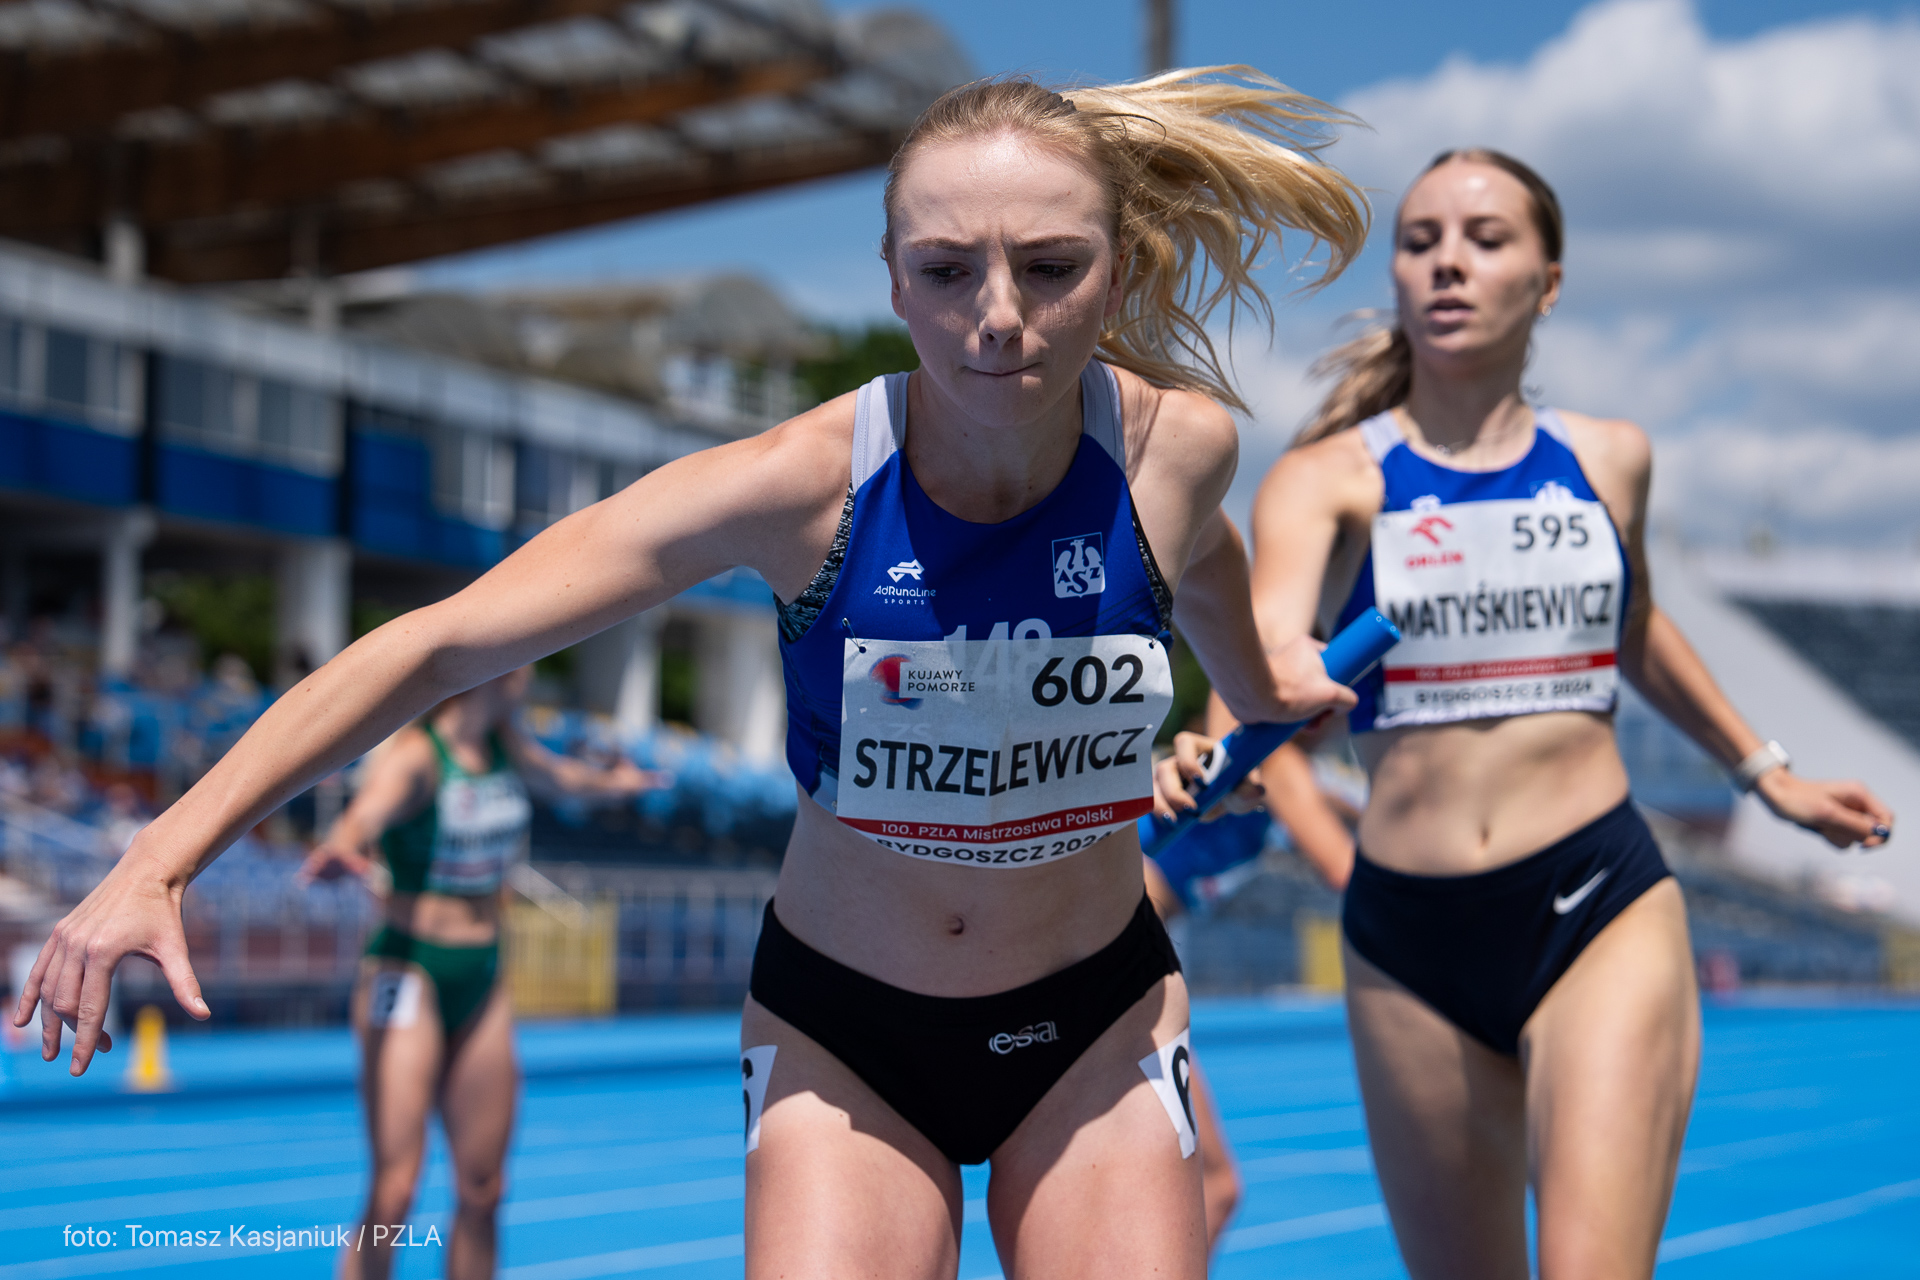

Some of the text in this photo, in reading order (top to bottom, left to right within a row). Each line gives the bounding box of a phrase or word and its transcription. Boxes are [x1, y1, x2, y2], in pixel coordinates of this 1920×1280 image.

[1513, 513, 1589, 550] 595
[1389, 579, 1613, 638] MATYŚKIEWICZ
[907, 682, 976, 692] POMORZE
[908, 670, 963, 680] KUJAWY
[1031, 653, 1145, 707] 602
[853, 726, 1147, 797] STRZELEWICZ
[881, 806, 1113, 841] 100. PZLA Mistrzostwa Polski
